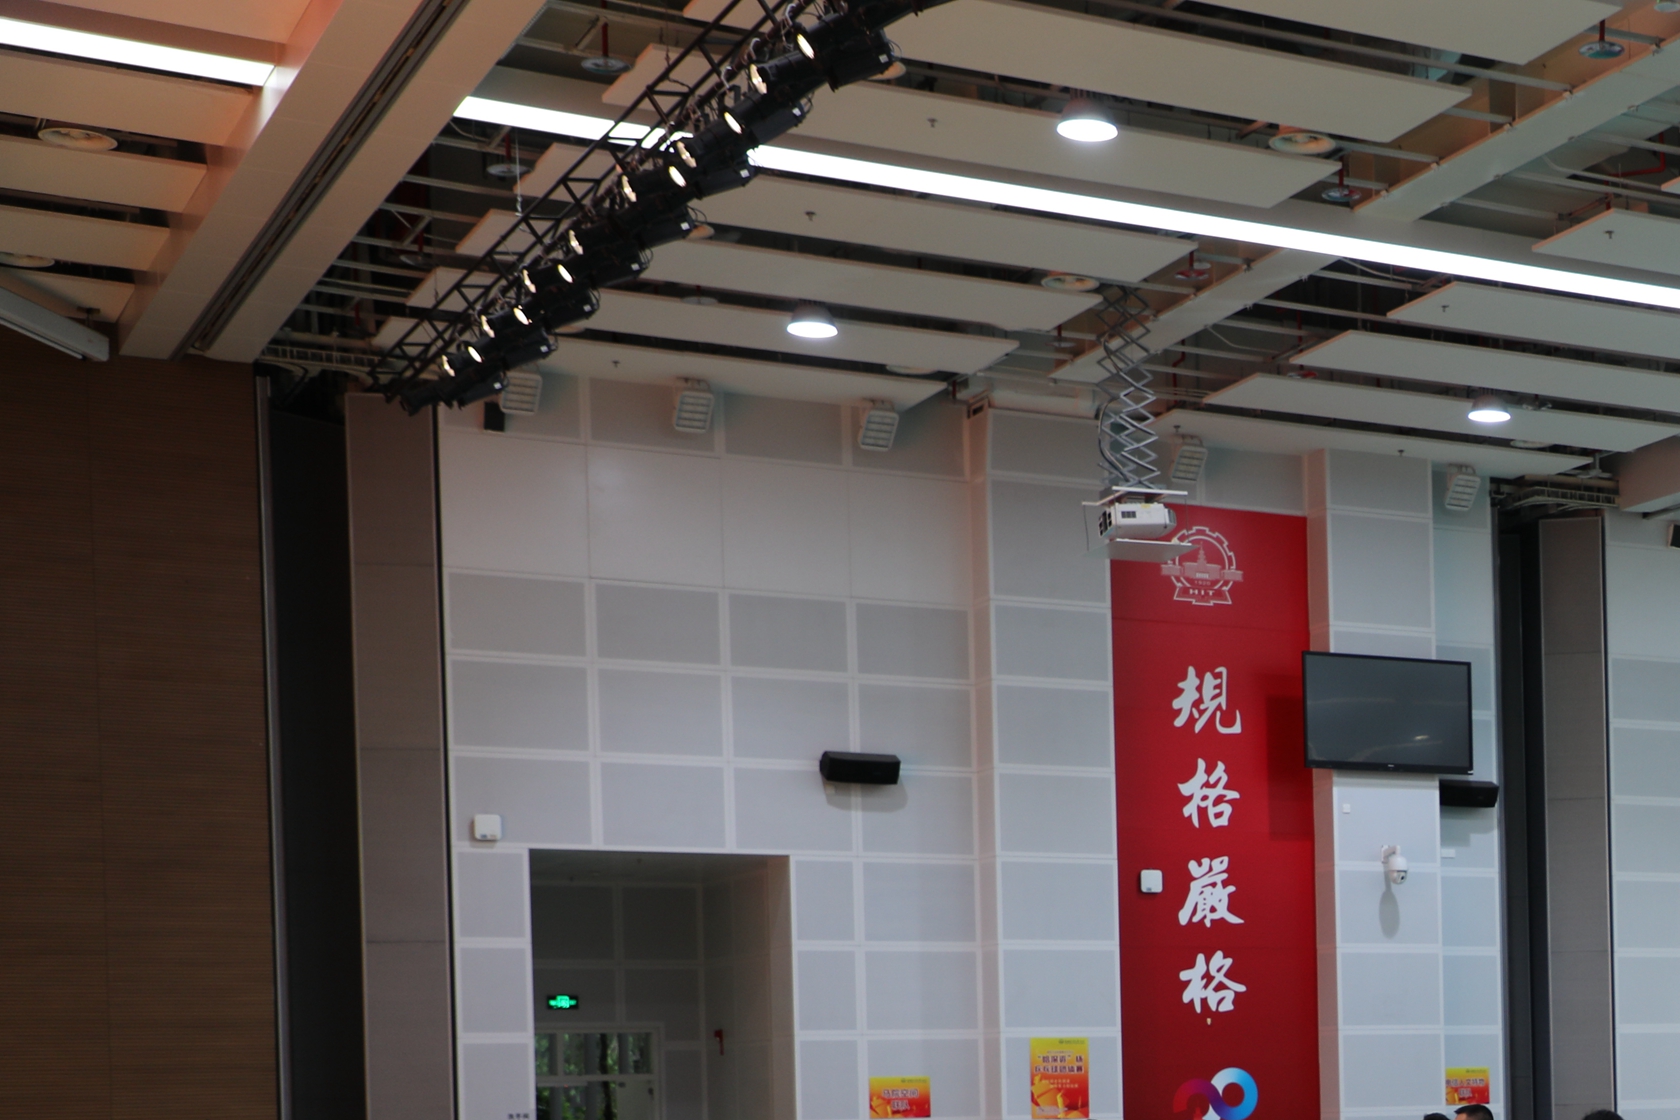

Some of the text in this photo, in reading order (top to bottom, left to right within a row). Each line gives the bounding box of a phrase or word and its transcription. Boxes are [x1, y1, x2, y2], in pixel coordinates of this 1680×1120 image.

[1189, 588, 1215, 596] HIT
[1172, 666, 1247, 1014] 規格嚴格
